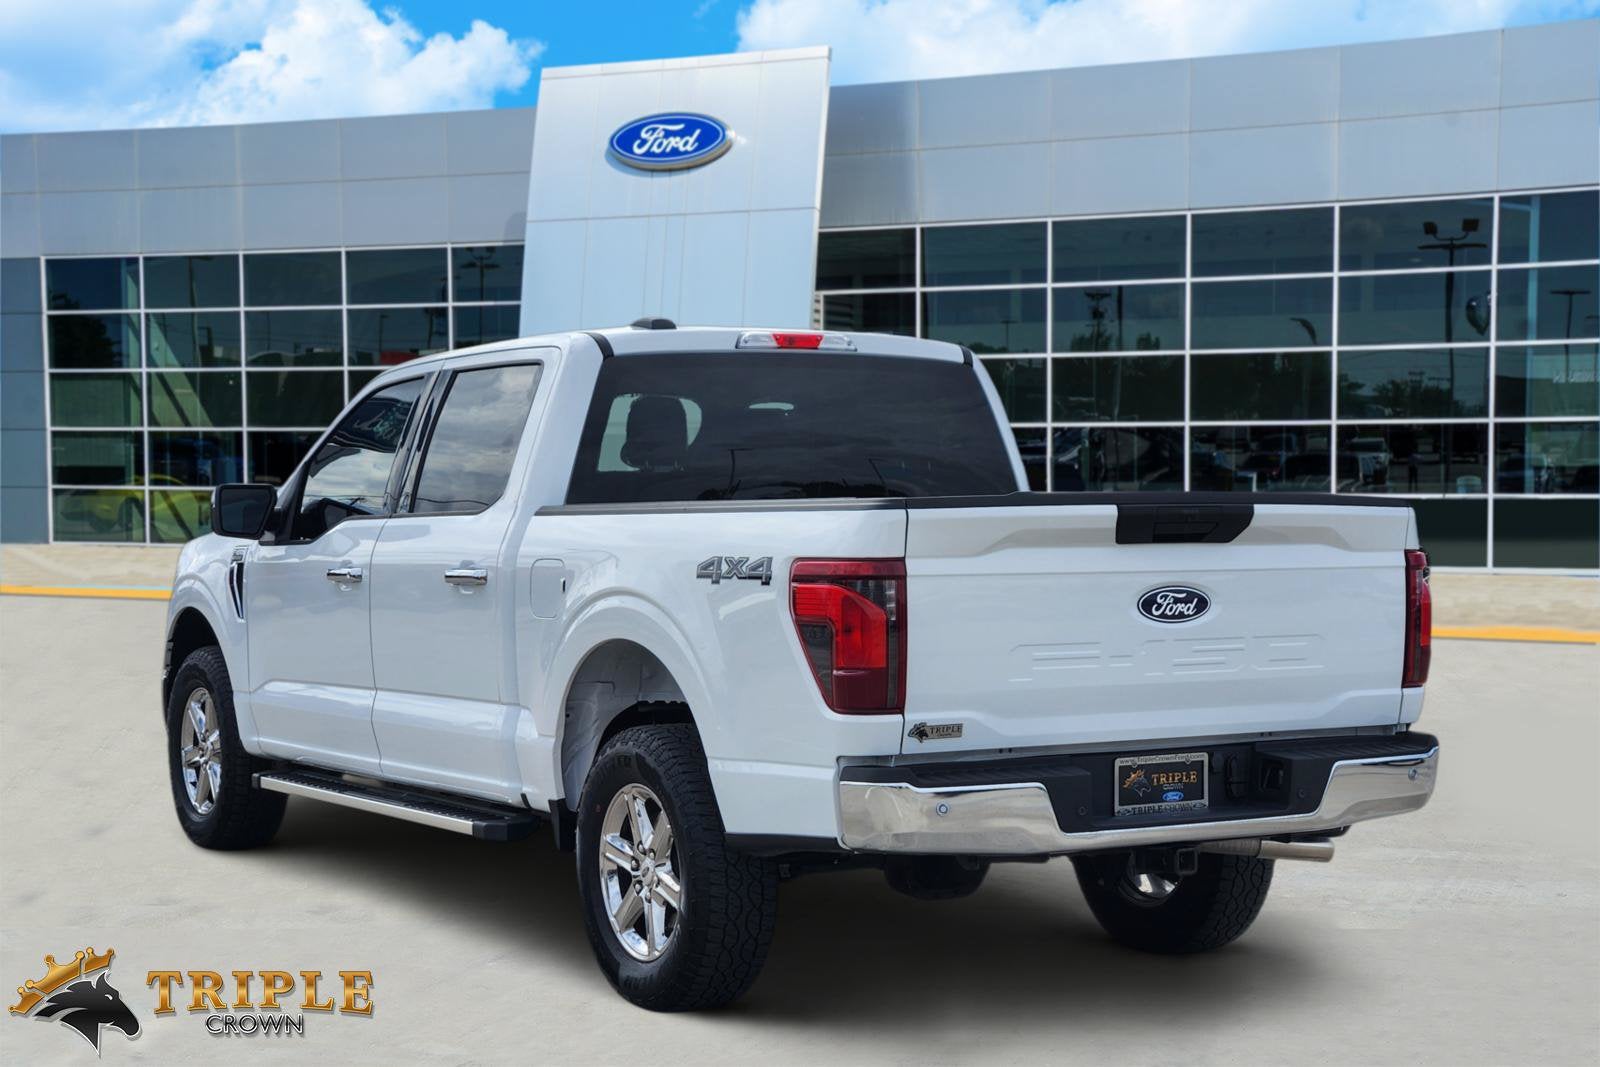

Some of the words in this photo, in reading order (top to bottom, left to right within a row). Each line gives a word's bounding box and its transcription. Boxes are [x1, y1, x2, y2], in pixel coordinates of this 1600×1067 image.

[633, 123, 701, 154] Ford
[1151, 592, 1198, 616] Ford
[930, 725, 961, 734] TRIPLE
[1152, 771, 1198, 786] TRIPLE
